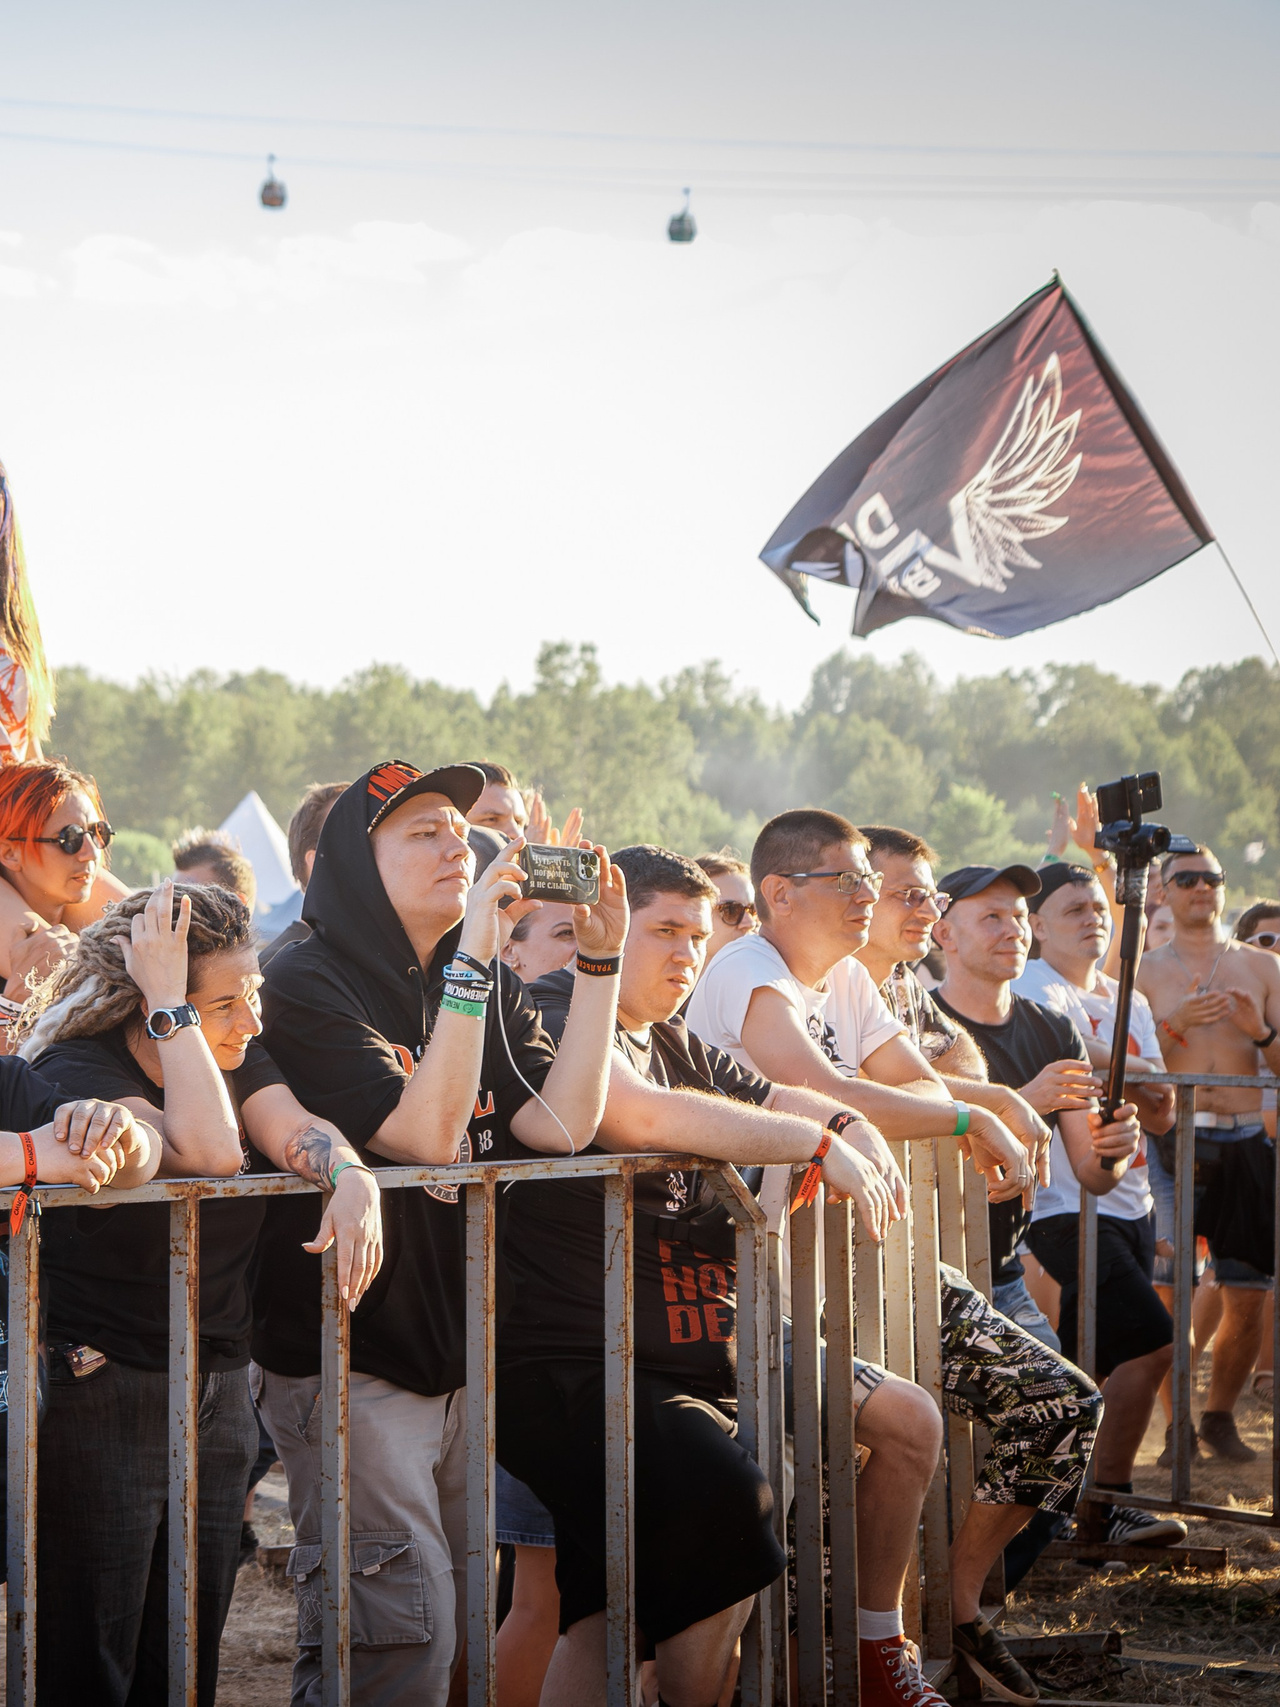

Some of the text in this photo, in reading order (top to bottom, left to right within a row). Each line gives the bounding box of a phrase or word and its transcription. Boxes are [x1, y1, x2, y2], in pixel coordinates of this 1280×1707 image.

[532, 854, 571, 868] Чуть-чуть
[547, 882, 573, 893] слышу
[13, 1193, 26, 1216] СМЫСЛ
